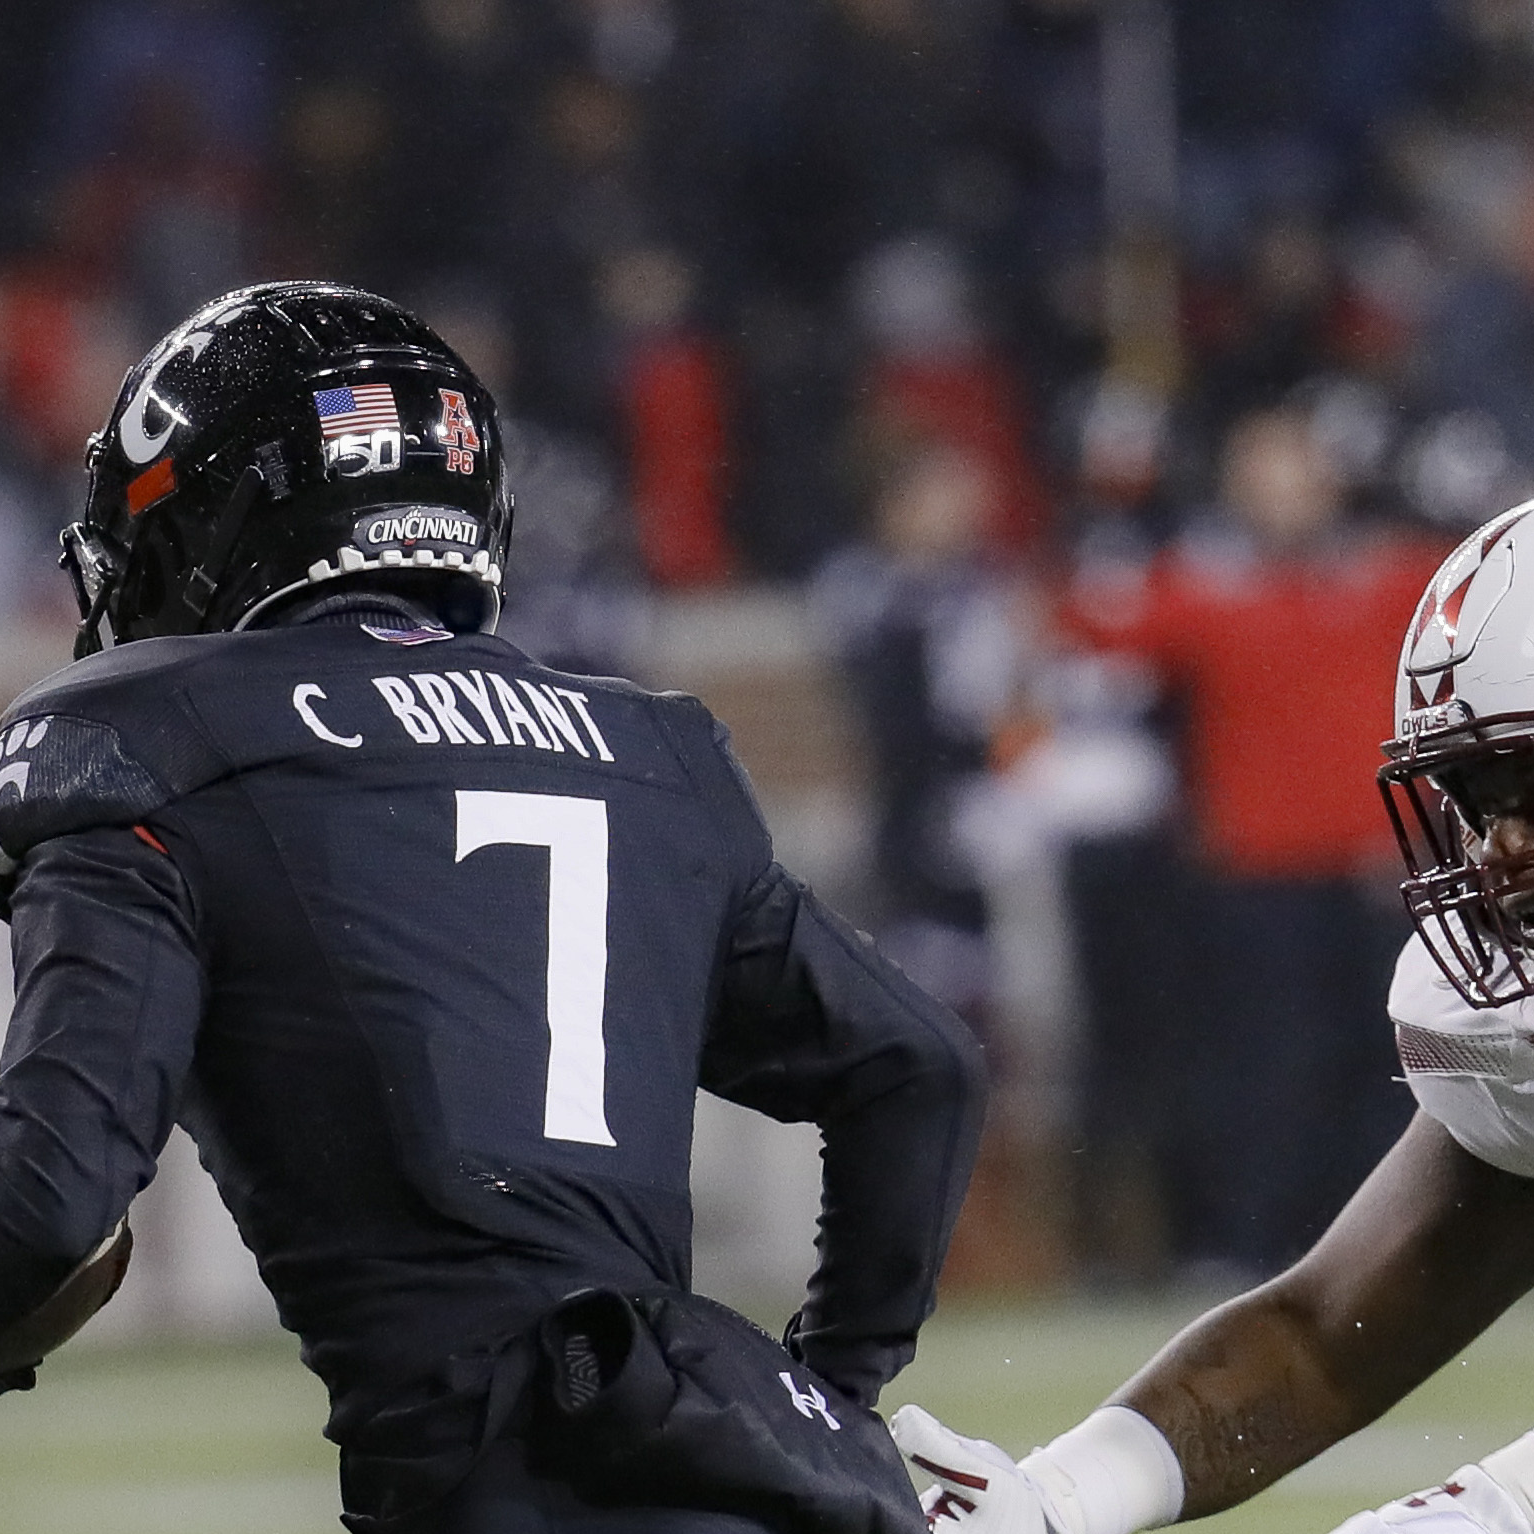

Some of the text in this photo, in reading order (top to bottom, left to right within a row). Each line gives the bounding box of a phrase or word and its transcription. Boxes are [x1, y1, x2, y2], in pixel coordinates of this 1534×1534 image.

[446, 446, 475, 475] P6
[368, 510, 479, 546] CINCINNATI
[292, 669, 615, 762] C BRYANT
[454, 789, 618, 1147] 7
